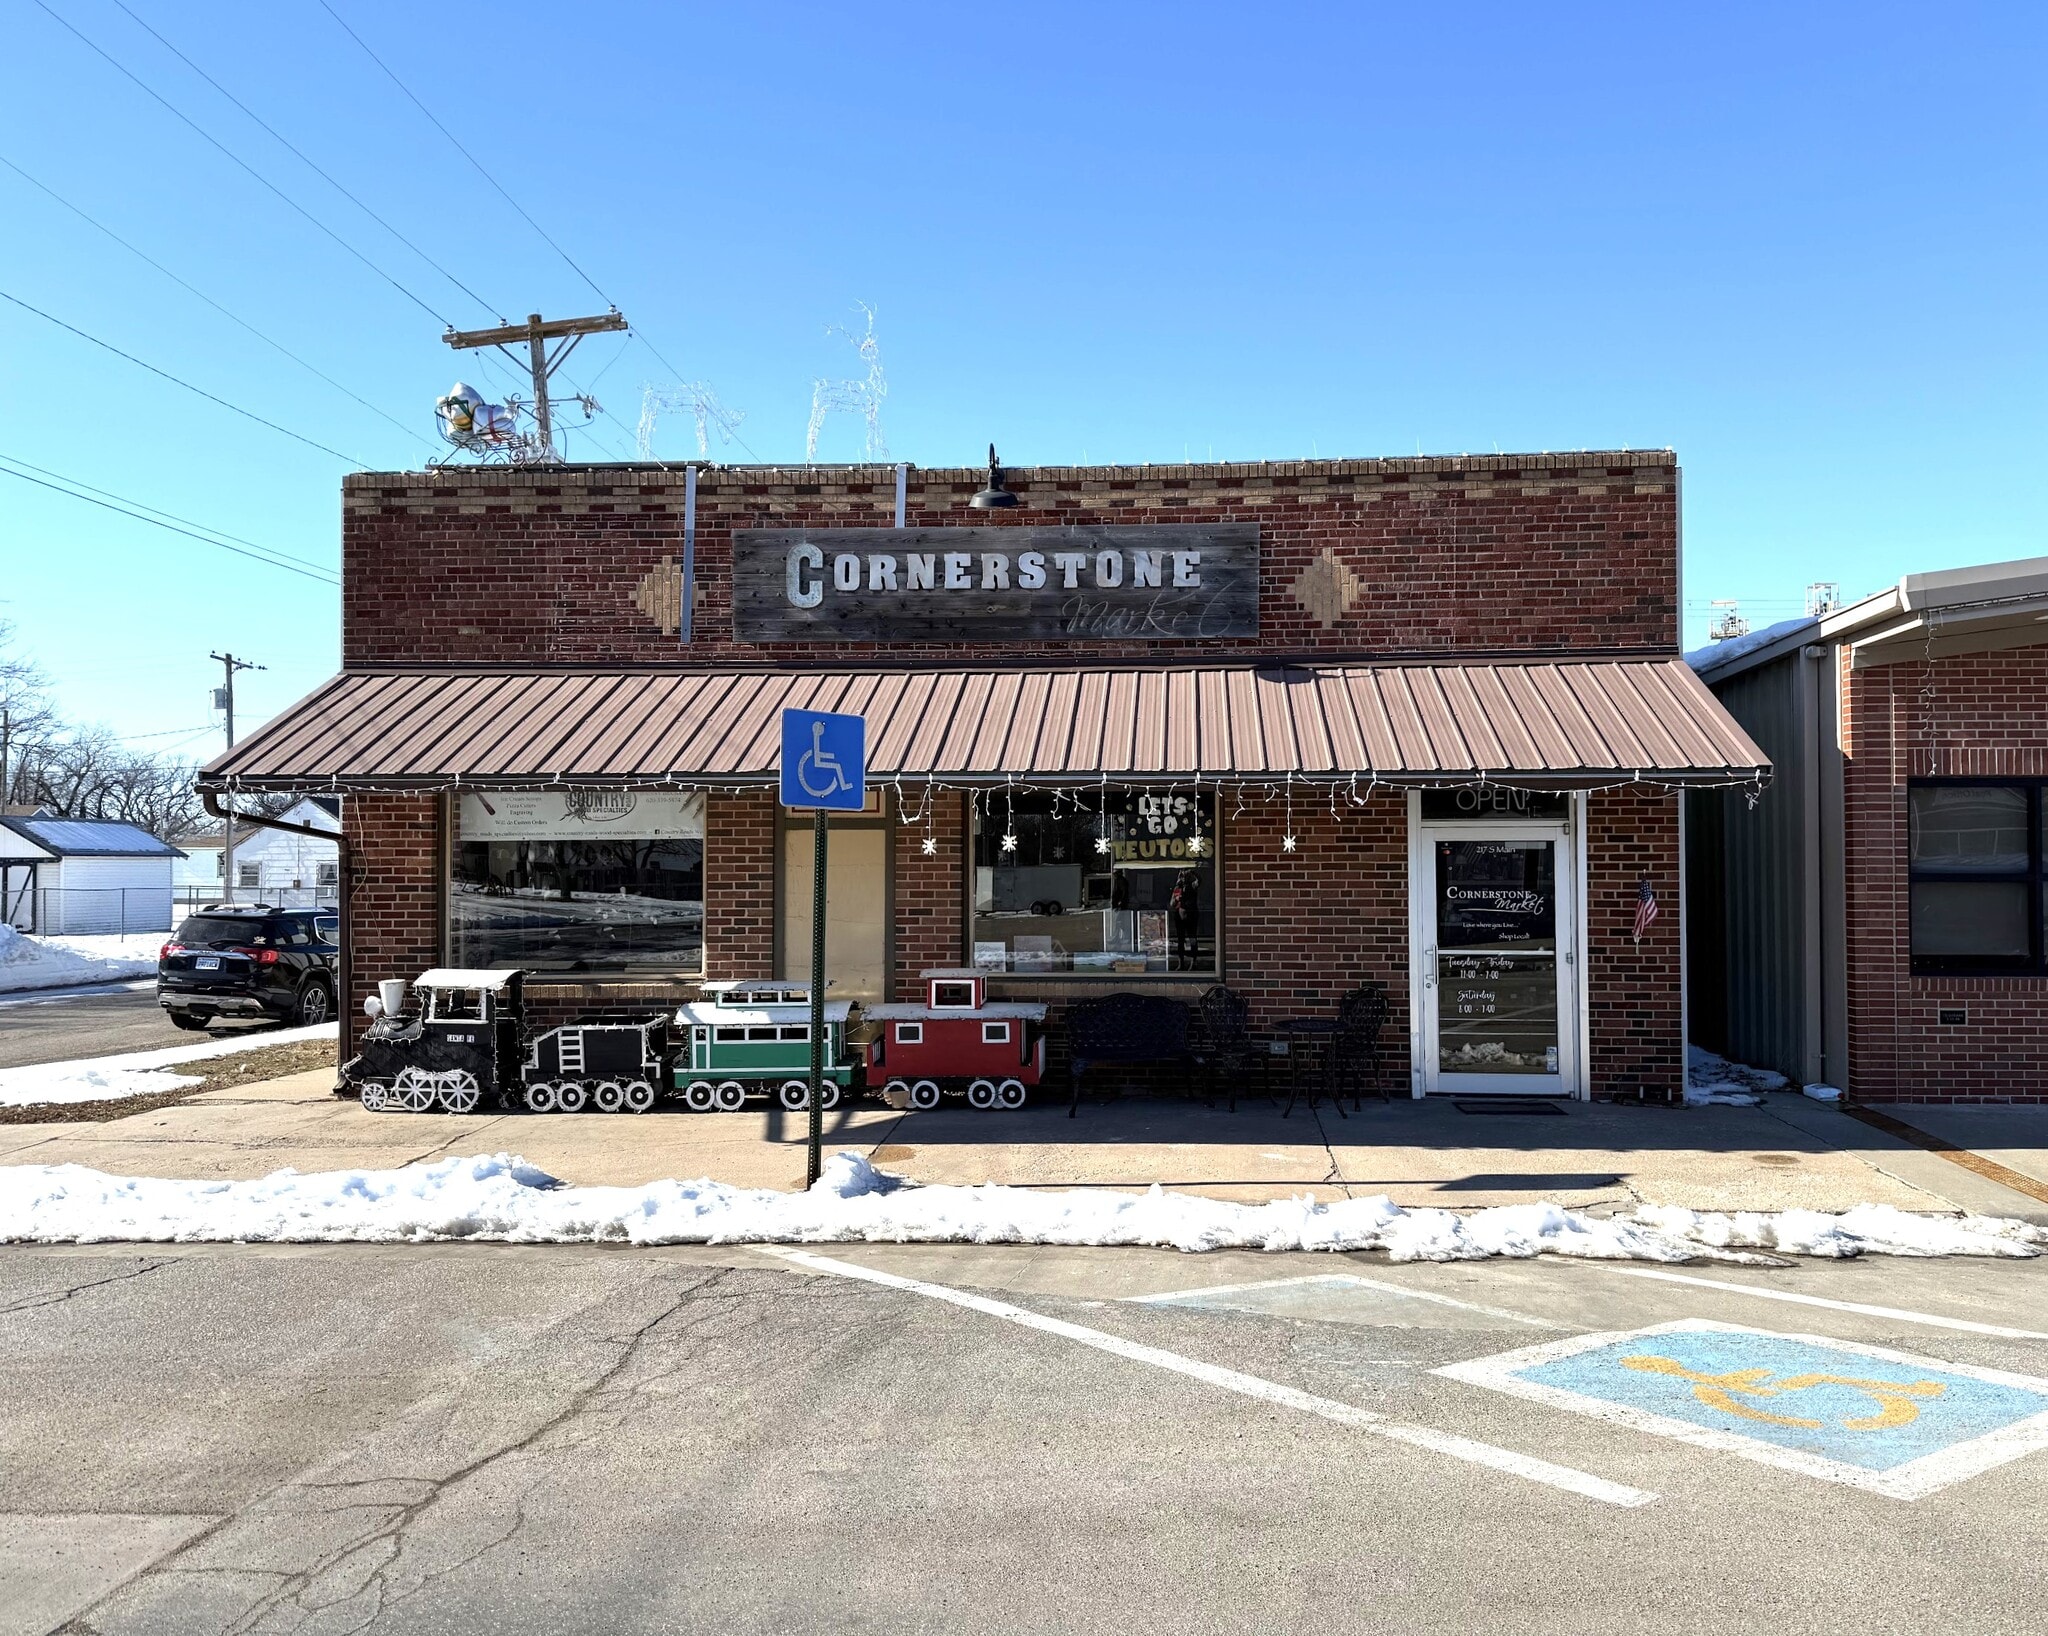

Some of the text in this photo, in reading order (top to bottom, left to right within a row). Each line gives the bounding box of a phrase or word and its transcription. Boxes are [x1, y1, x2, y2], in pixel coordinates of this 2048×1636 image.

[786, 542, 1200, 608] CORNERSTONE
[1062, 580, 1237, 635] Market
[1456, 788, 1526, 811] OPEN
[1148, 816, 1178, 835] GO
[1488, 845, 1495, 854] S
[1496, 845, 1516, 854] Main
[1446, 886, 1532, 899] CORNERSTONE
[1494, 894, 1544, 915] Market
[1445, 956, 1480, 969] Tuesday
[1486, 956, 1515, 969] Friday
[1457, 989, 1496, 1002] Saturday
